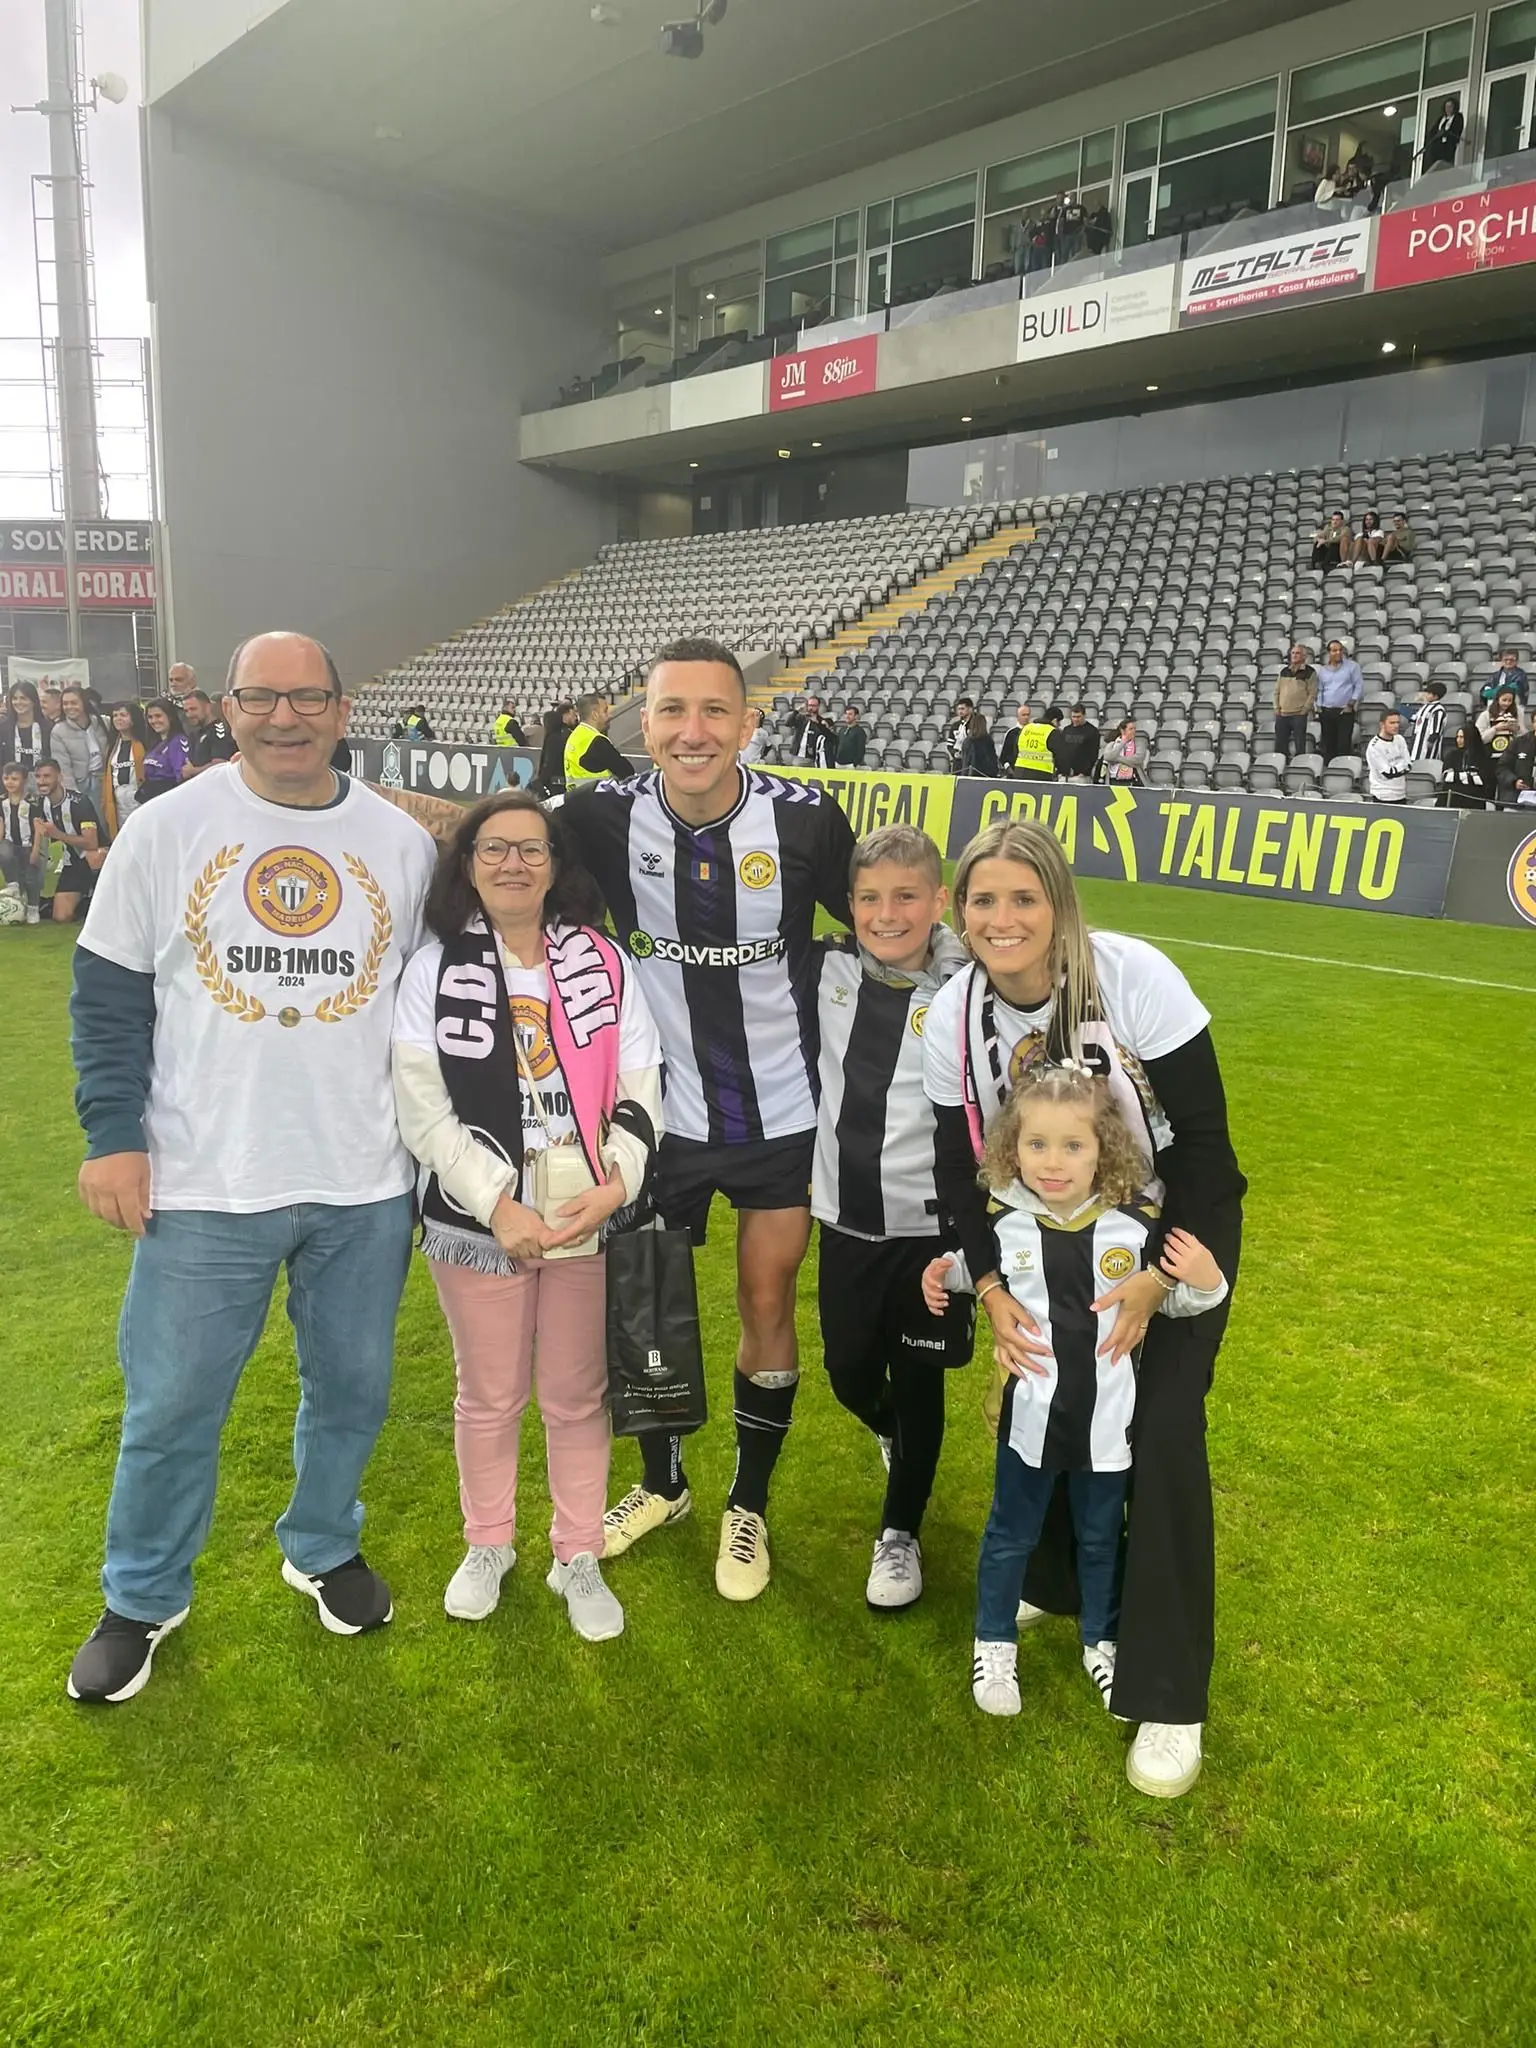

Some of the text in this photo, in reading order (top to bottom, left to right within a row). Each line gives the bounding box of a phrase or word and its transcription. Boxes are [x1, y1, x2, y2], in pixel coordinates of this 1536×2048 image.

[1411, 194, 1491, 222] LION
[1191, 233, 1362, 289] METALTEC
[1278, 283, 1304, 294] Casas
[1306, 272, 1355, 289] Modulares
[1023, 300, 1101, 342] BUILD
[781, 360, 807, 388] JM
[76, 571, 157, 598] CORAL
[1159, 802, 1405, 901] TALENTO
[226, 945, 355, 977] SUB1MOS
[654, 938, 785, 966] SOLVERDE.PT
[278, 976, 305, 987] 2024
[902, 1333, 945, 1350] hummel
